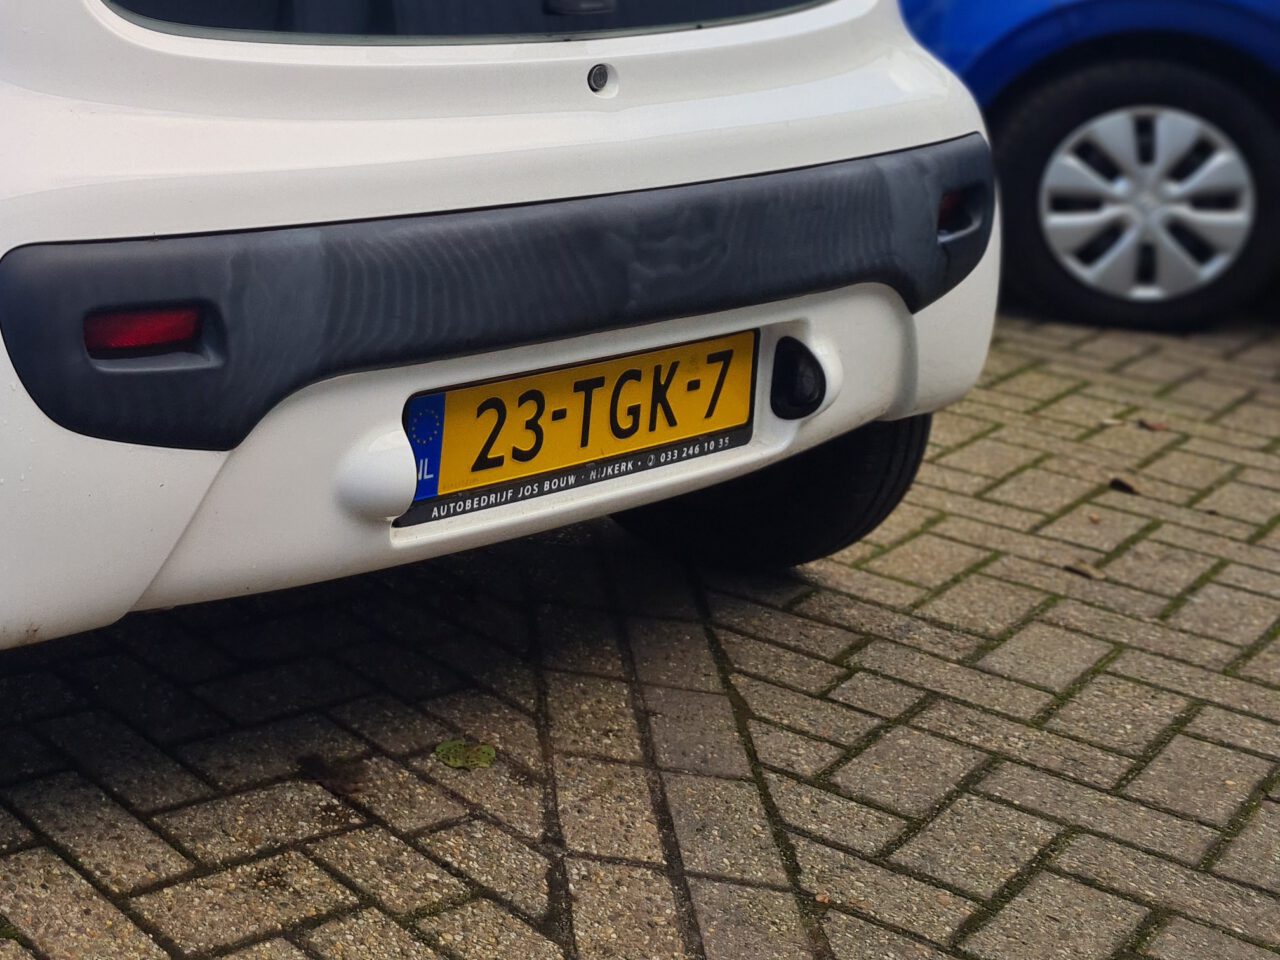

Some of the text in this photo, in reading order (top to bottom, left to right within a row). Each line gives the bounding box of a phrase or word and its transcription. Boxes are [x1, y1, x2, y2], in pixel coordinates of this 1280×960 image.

[471, 349, 734, 473] 23-TGK-7
[431, 489, 514, 518] AUTOBEDRIJF
[518, 484, 539, 498] JOS
[543, 475, 577, 491] BOUW
[660, 449, 678, 463] 033
[681, 444, 700, 458] 246
[704, 440, 715, 452] 10
[718, 436, 730, 449] 35
